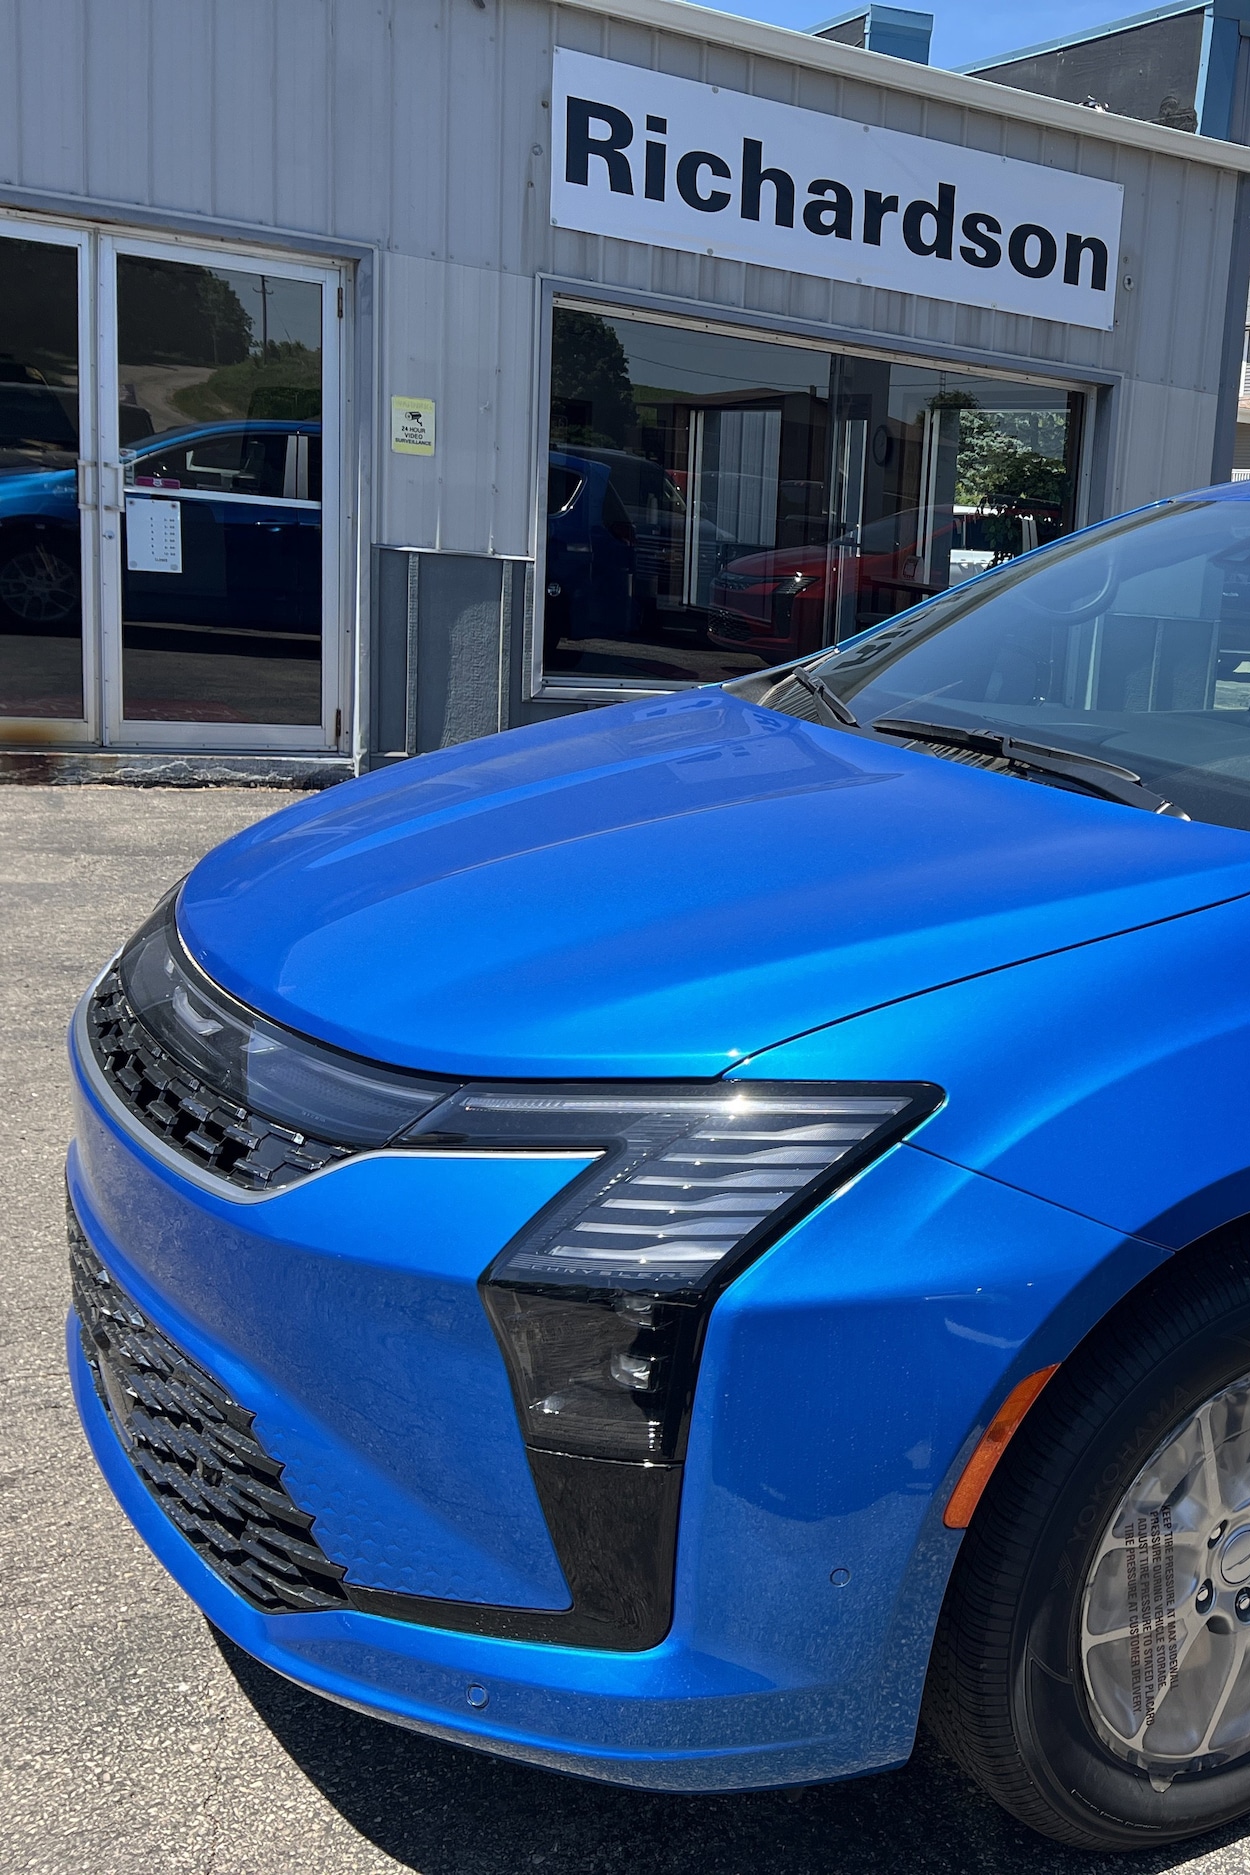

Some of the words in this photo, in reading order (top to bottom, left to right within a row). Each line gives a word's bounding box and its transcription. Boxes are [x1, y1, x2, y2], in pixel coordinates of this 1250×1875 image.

[566, 96, 1108, 292] Richardson
[395, 438, 431, 446] SURVEILLANCE
[531, 1265, 677, 1278] CHRYSLER
[1066, 1384, 1191, 1545] YOKOHAMA
[1125, 1523, 1134, 1546] TIRE
[1161, 1505, 1172, 1528] KEEP
[1138, 1518, 1148, 1554] ADJUST
[1150, 1511, 1162, 1563] PRESSURE
[1164, 1531, 1174, 1554] TIRE
[1126, 1548, 1137, 1599] PRESSURE
[1140, 1556, 1149, 1580] TIRE
[1153, 1565, 1163, 1602] DURING
[1165, 1555, 1175, 1606] PRESSURE
[1128, 1601, 1137, 1612] AT
[1141, 1581, 1151, 1633] PRESSURE
[1155, 1603, 1165, 1644] VEHICLE
[1167, 1608, 1176, 1618] AT
[1129, 1615, 1140, 1668] CUSTOMER
[1143, 1633, 1152, 1646] TO
[1168, 1621, 1177, 1643] MAX
[1144, 1649, 1153, 1682] STATED
[1169, 1644, 1179, 1692] SIDEWALL
[1145, 1684, 1155, 1726] PLACARD
